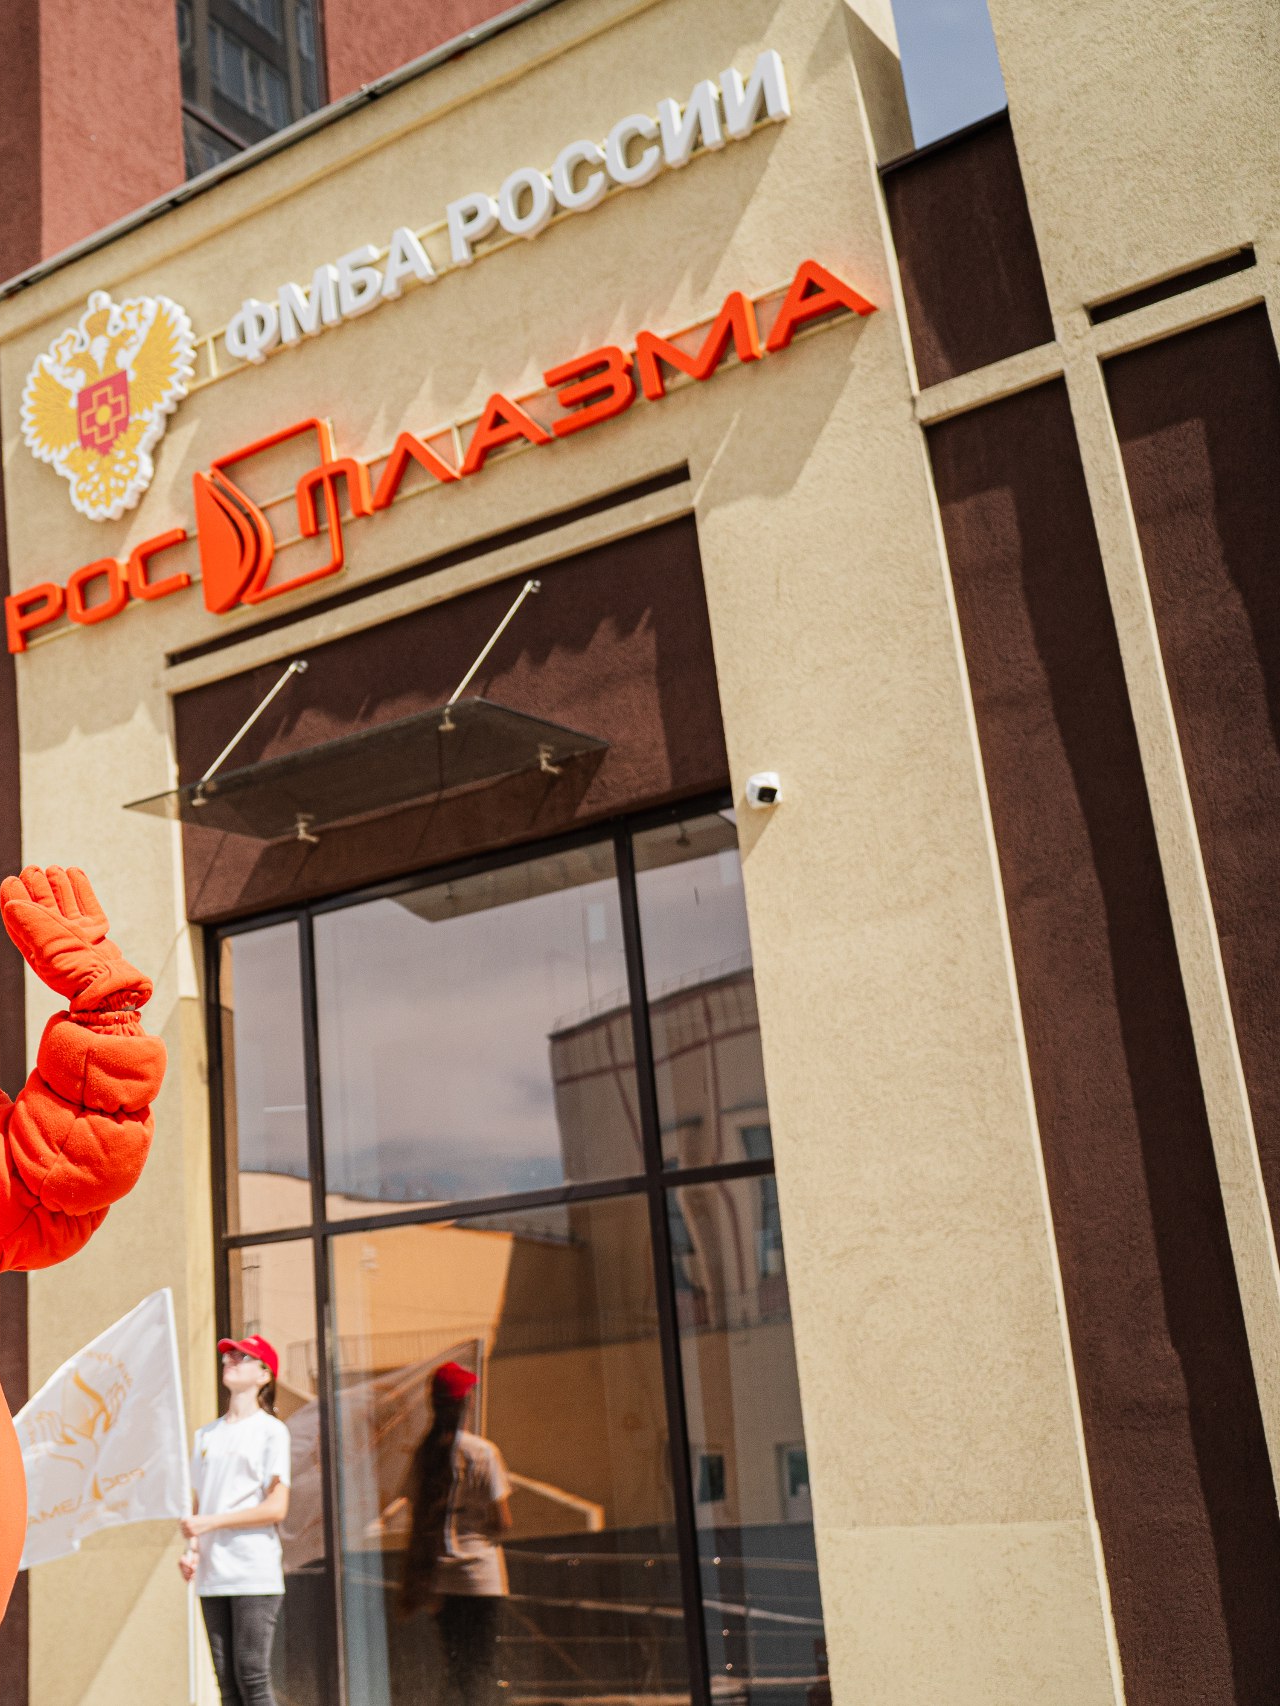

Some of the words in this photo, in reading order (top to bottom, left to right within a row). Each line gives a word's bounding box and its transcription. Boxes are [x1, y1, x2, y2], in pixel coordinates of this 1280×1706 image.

[224, 226, 436, 364] ФМБА
[446, 49, 792, 267] РОССИИ
[5, 528, 191, 653] РОС
